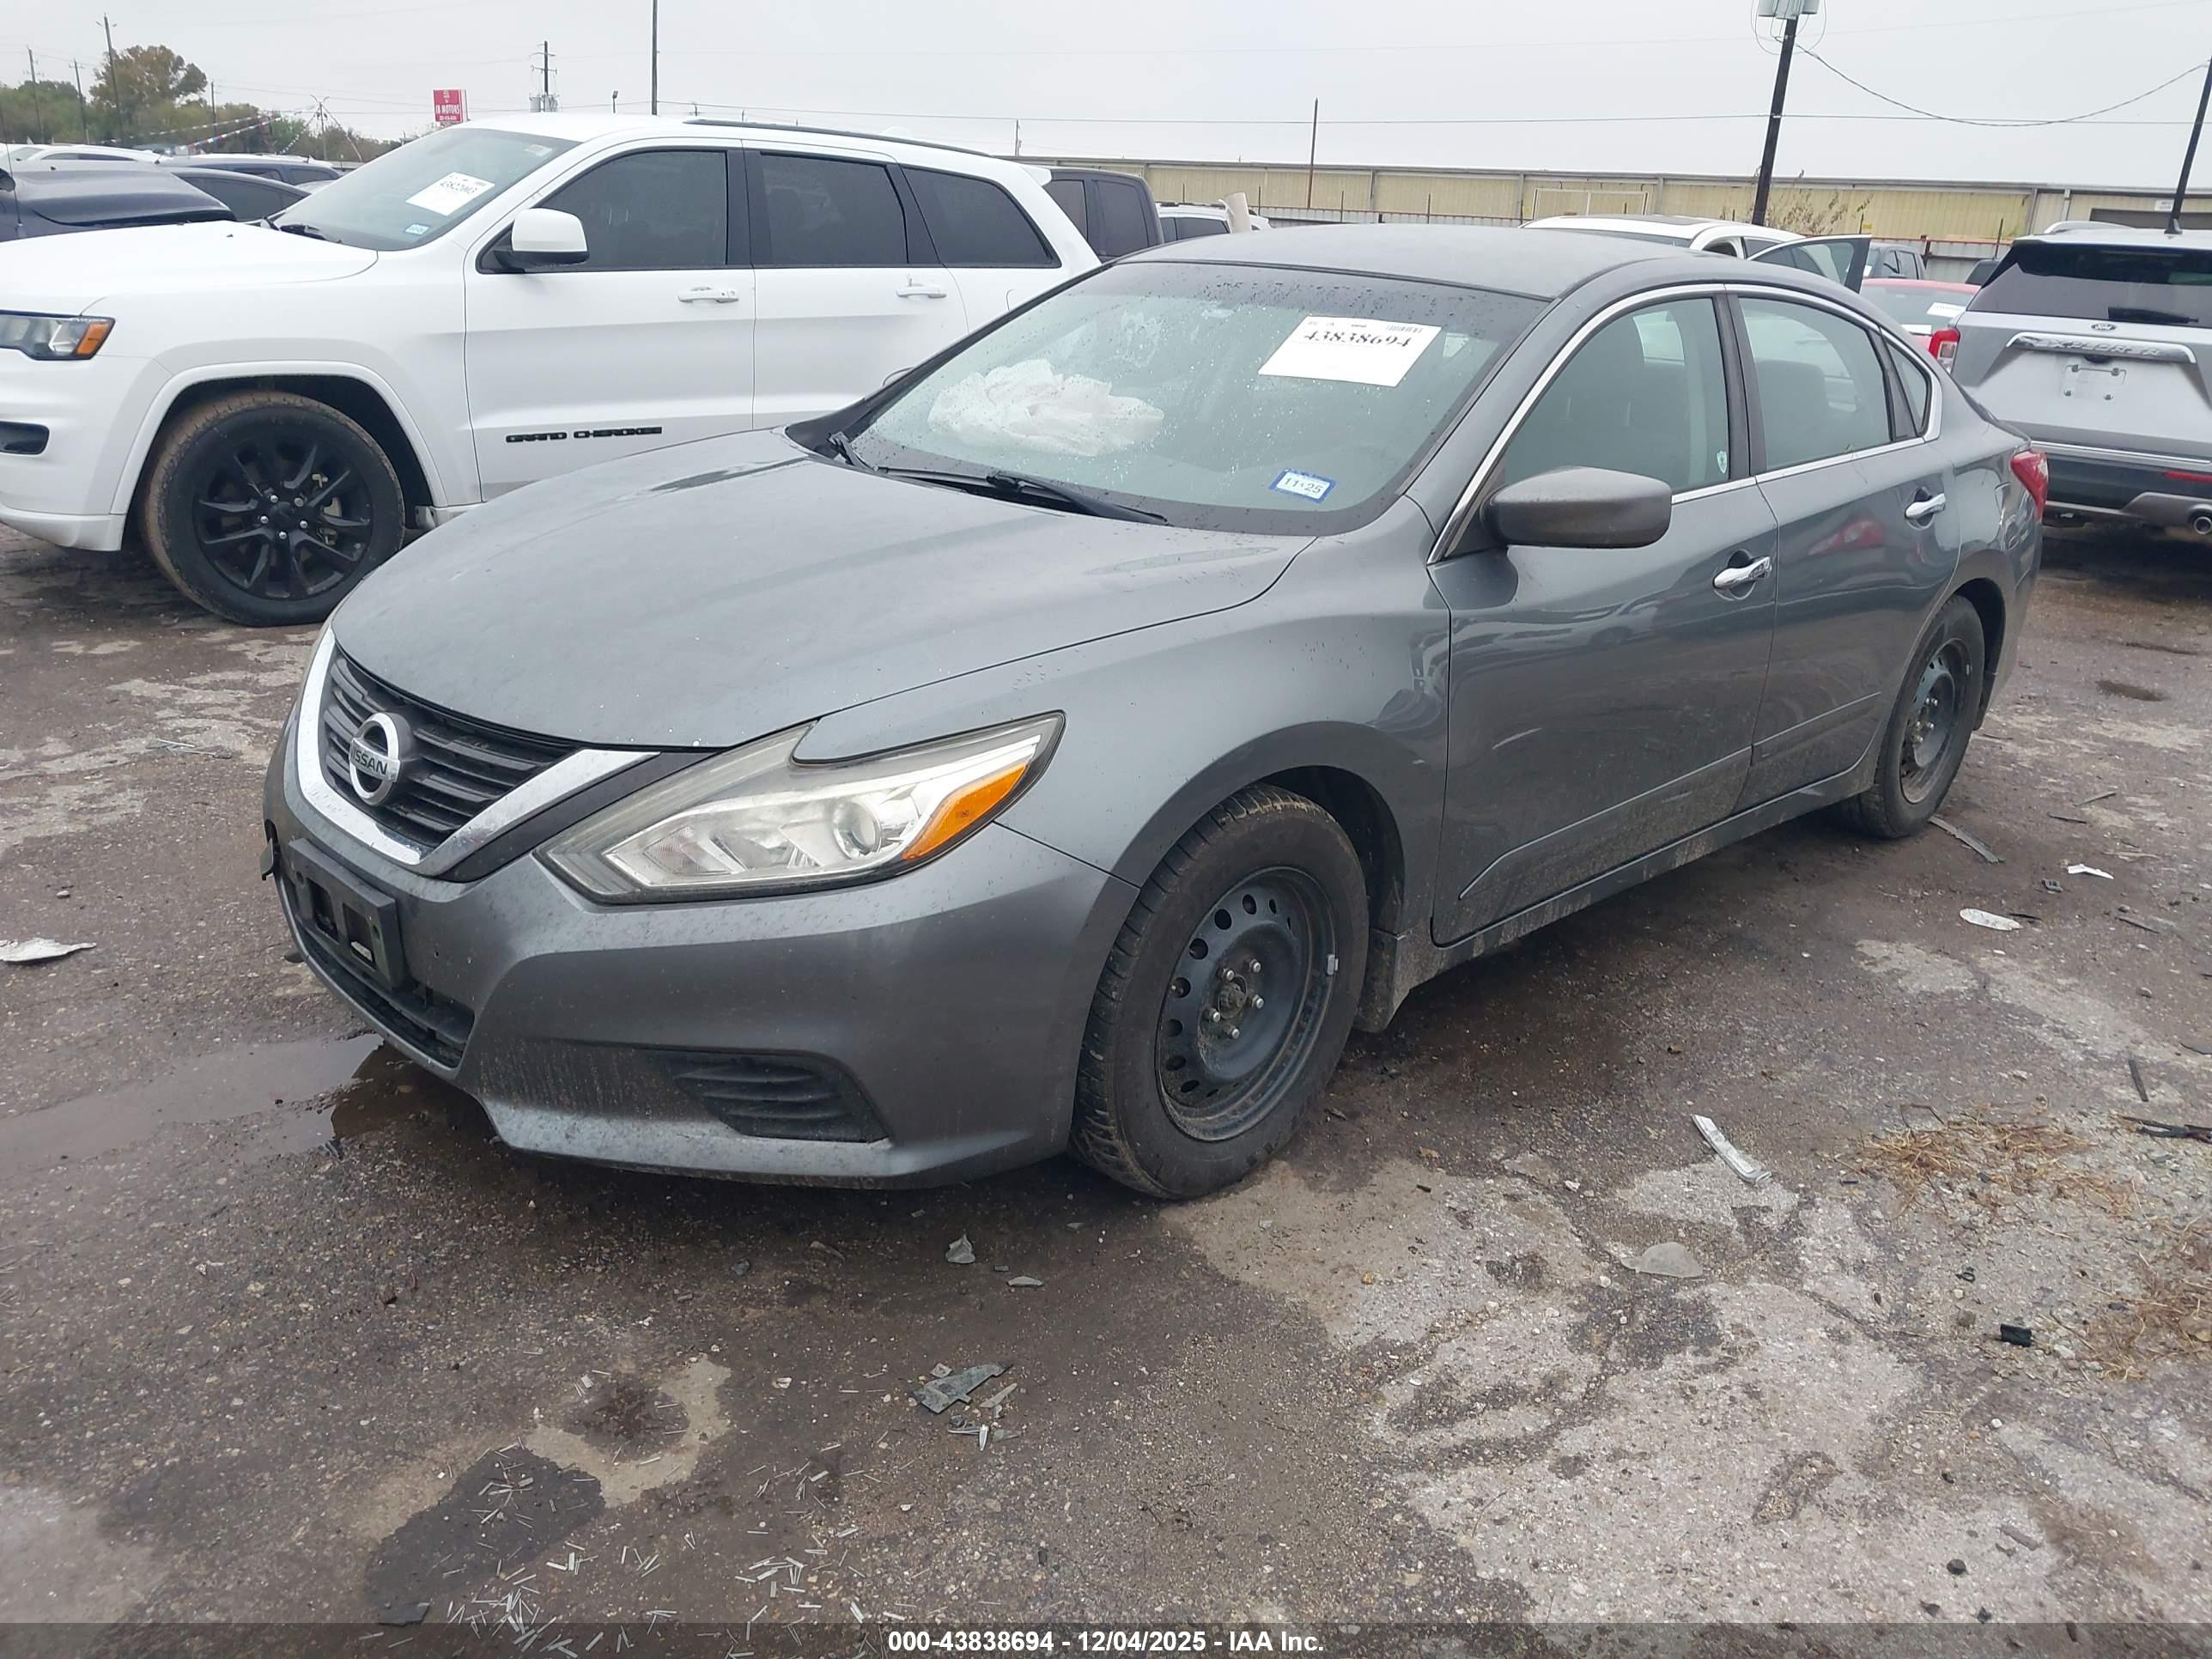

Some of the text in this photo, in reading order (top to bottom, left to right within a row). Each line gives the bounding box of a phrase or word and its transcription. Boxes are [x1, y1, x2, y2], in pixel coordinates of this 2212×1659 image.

[1304, 330, 1413, 347] 43838694
[506, 426, 662, 443] GRAND CHEROKEE
